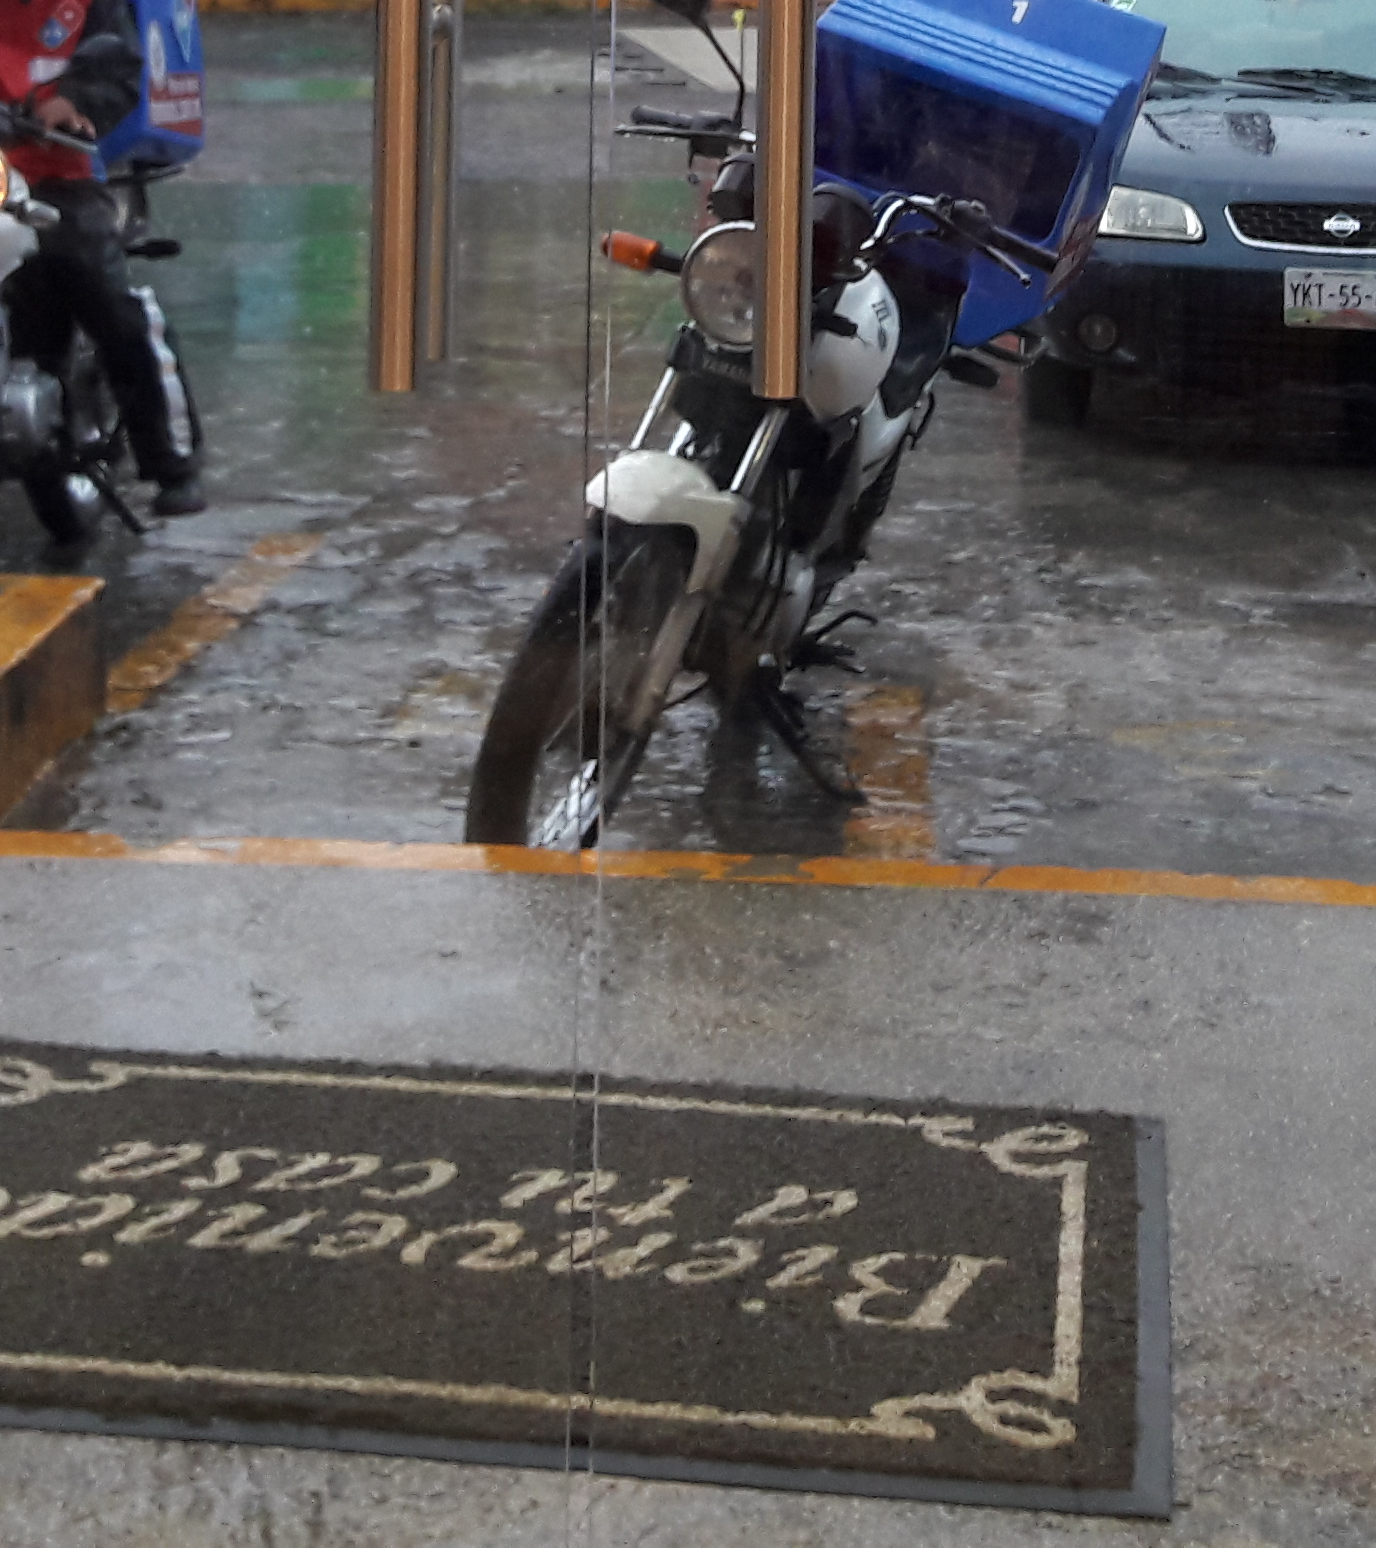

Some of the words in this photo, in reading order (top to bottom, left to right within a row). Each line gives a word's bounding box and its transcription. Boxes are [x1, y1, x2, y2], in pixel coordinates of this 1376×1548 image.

[76, 1139, 458, 1208] casa
[500, 1166, 691, 1231] tu
[734, 1187, 860, 1236] a
